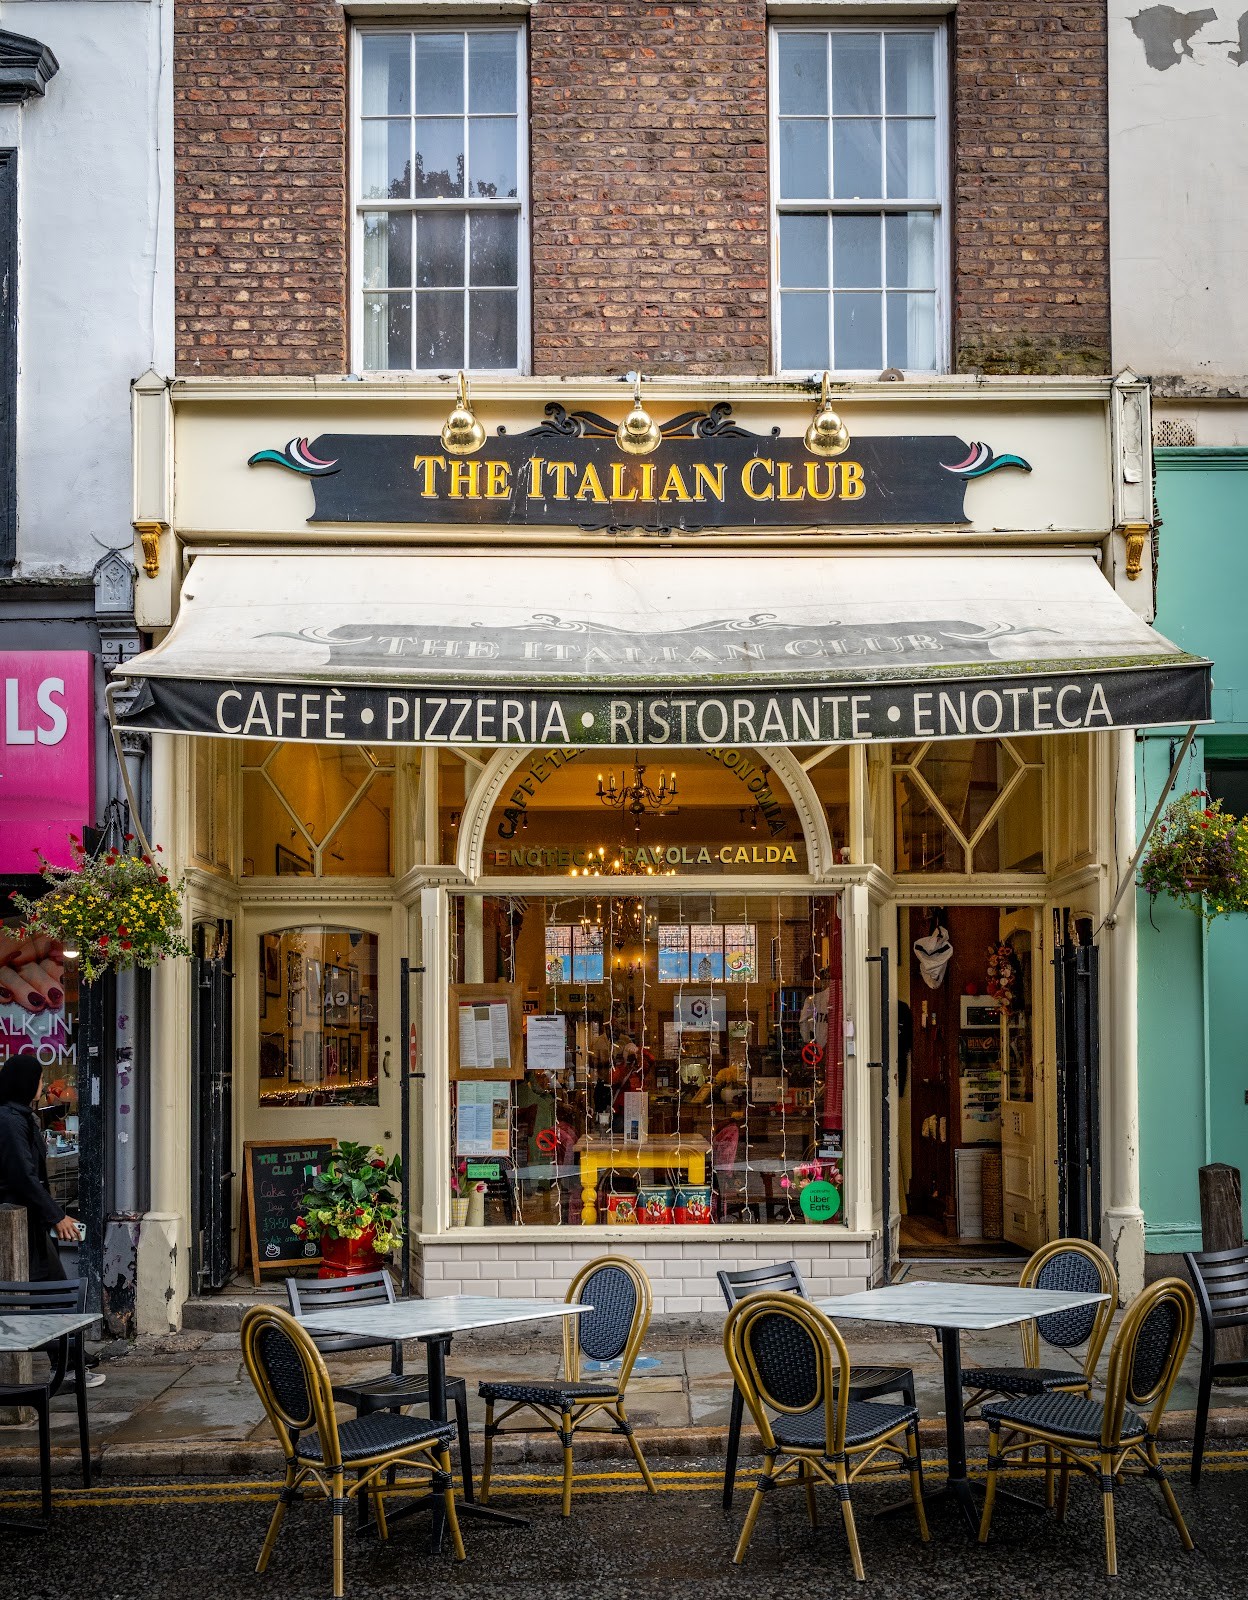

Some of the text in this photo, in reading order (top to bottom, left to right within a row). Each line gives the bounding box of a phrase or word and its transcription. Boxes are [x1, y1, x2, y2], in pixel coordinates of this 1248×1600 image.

[413, 454, 867, 503] THE ITALIAN CLUB
[378, 632, 945, 664] THE ITALIAN CLUB
[216, 683, 1114, 745] CAFFÈ PIZZERIA RISTORANTE ENOTECA
[494, 845, 798, 867] ENOTECA TAVOLA CALDA
[809, 1195, 830, 1203] Uber
[809, 1203, 831, 1212] Eats
